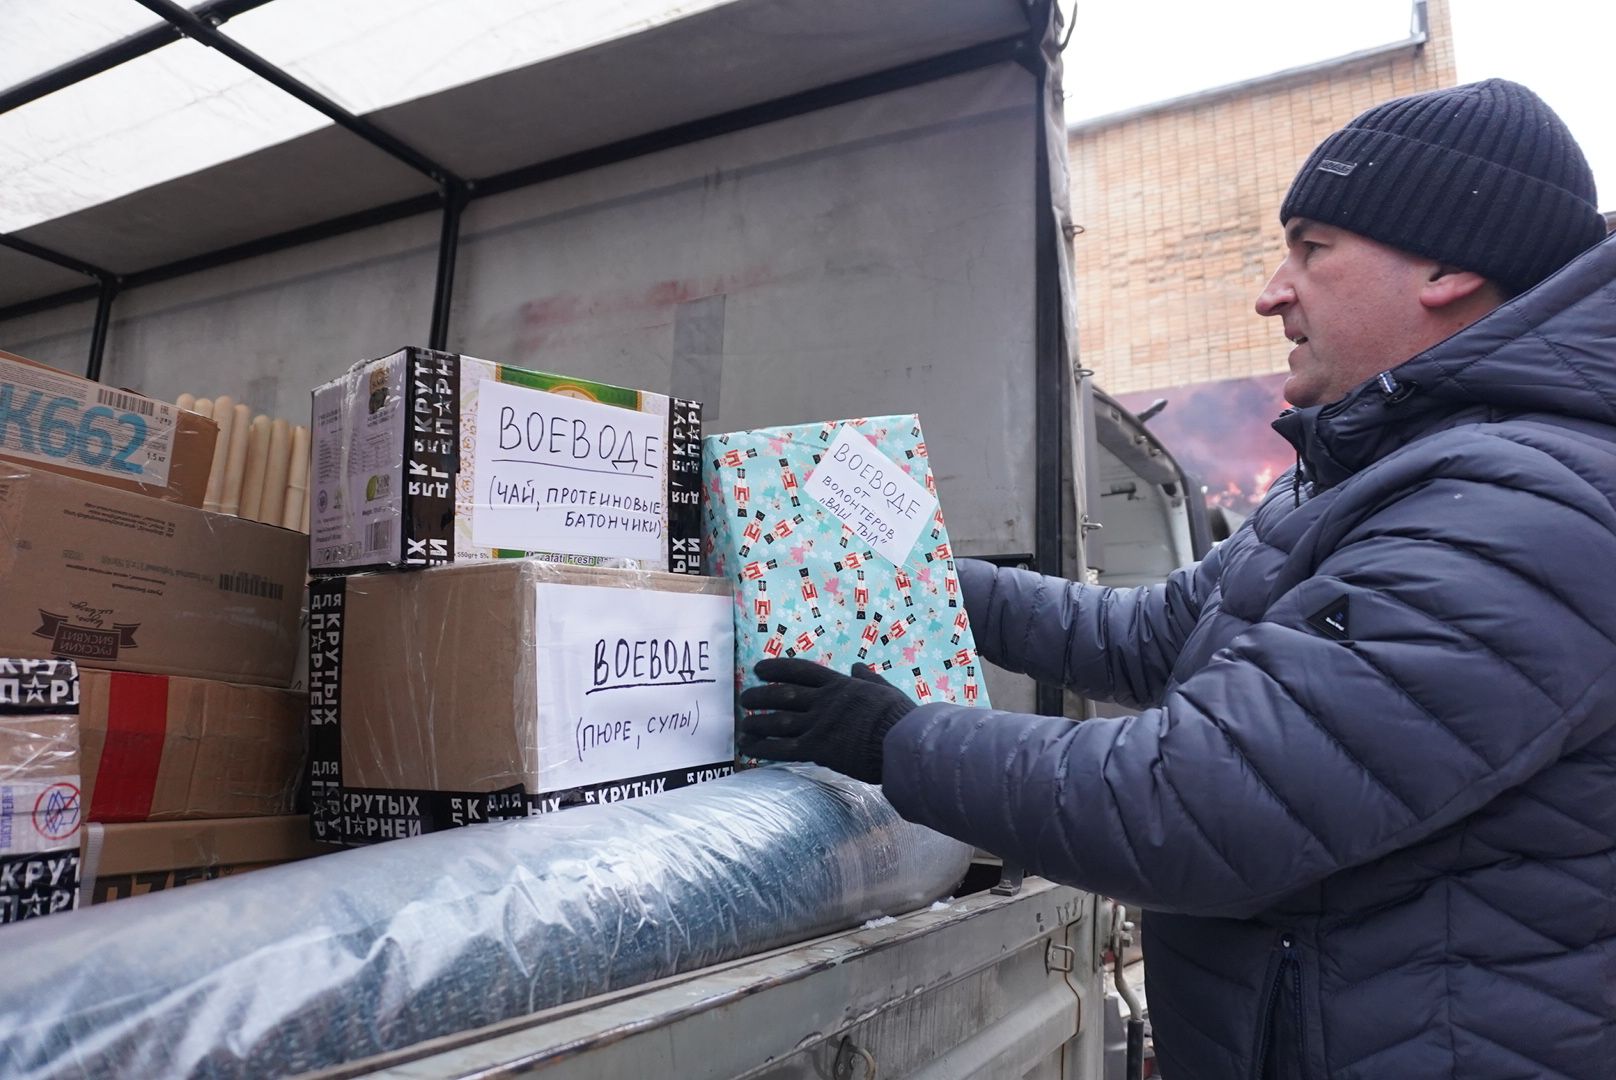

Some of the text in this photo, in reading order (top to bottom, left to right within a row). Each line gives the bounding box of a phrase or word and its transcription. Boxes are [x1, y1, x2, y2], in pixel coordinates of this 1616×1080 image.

[499, 406, 659, 472] ВОЕВОДЕ
[408, 481, 449, 498] ДЛЯ
[489, 475, 661, 515] (ЧАЙ, ПРОТЕИНОВЫЕ
[671, 490, 700, 505] ДЛЯ
[833, 443, 921, 520] ВОЕВОДЕ
[822, 475, 895, 540] ВОЛОНТЕРОВ
[564, 511, 662, 539] БАТОНЧИКИ)
[567, 553, 595, 565] Fresh
[312, 593, 342, 610] ДЛЯ
[60, 630, 115, 646] БИСКВИТ
[324, 613, 341, 725] КРУТЫХ
[593, 638, 710, 686] ВОЕВОДЕ
[576, 700, 700, 762] (ПЮРЕ, СУПЫ)
[311, 761, 339, 777] ДЛЯ
